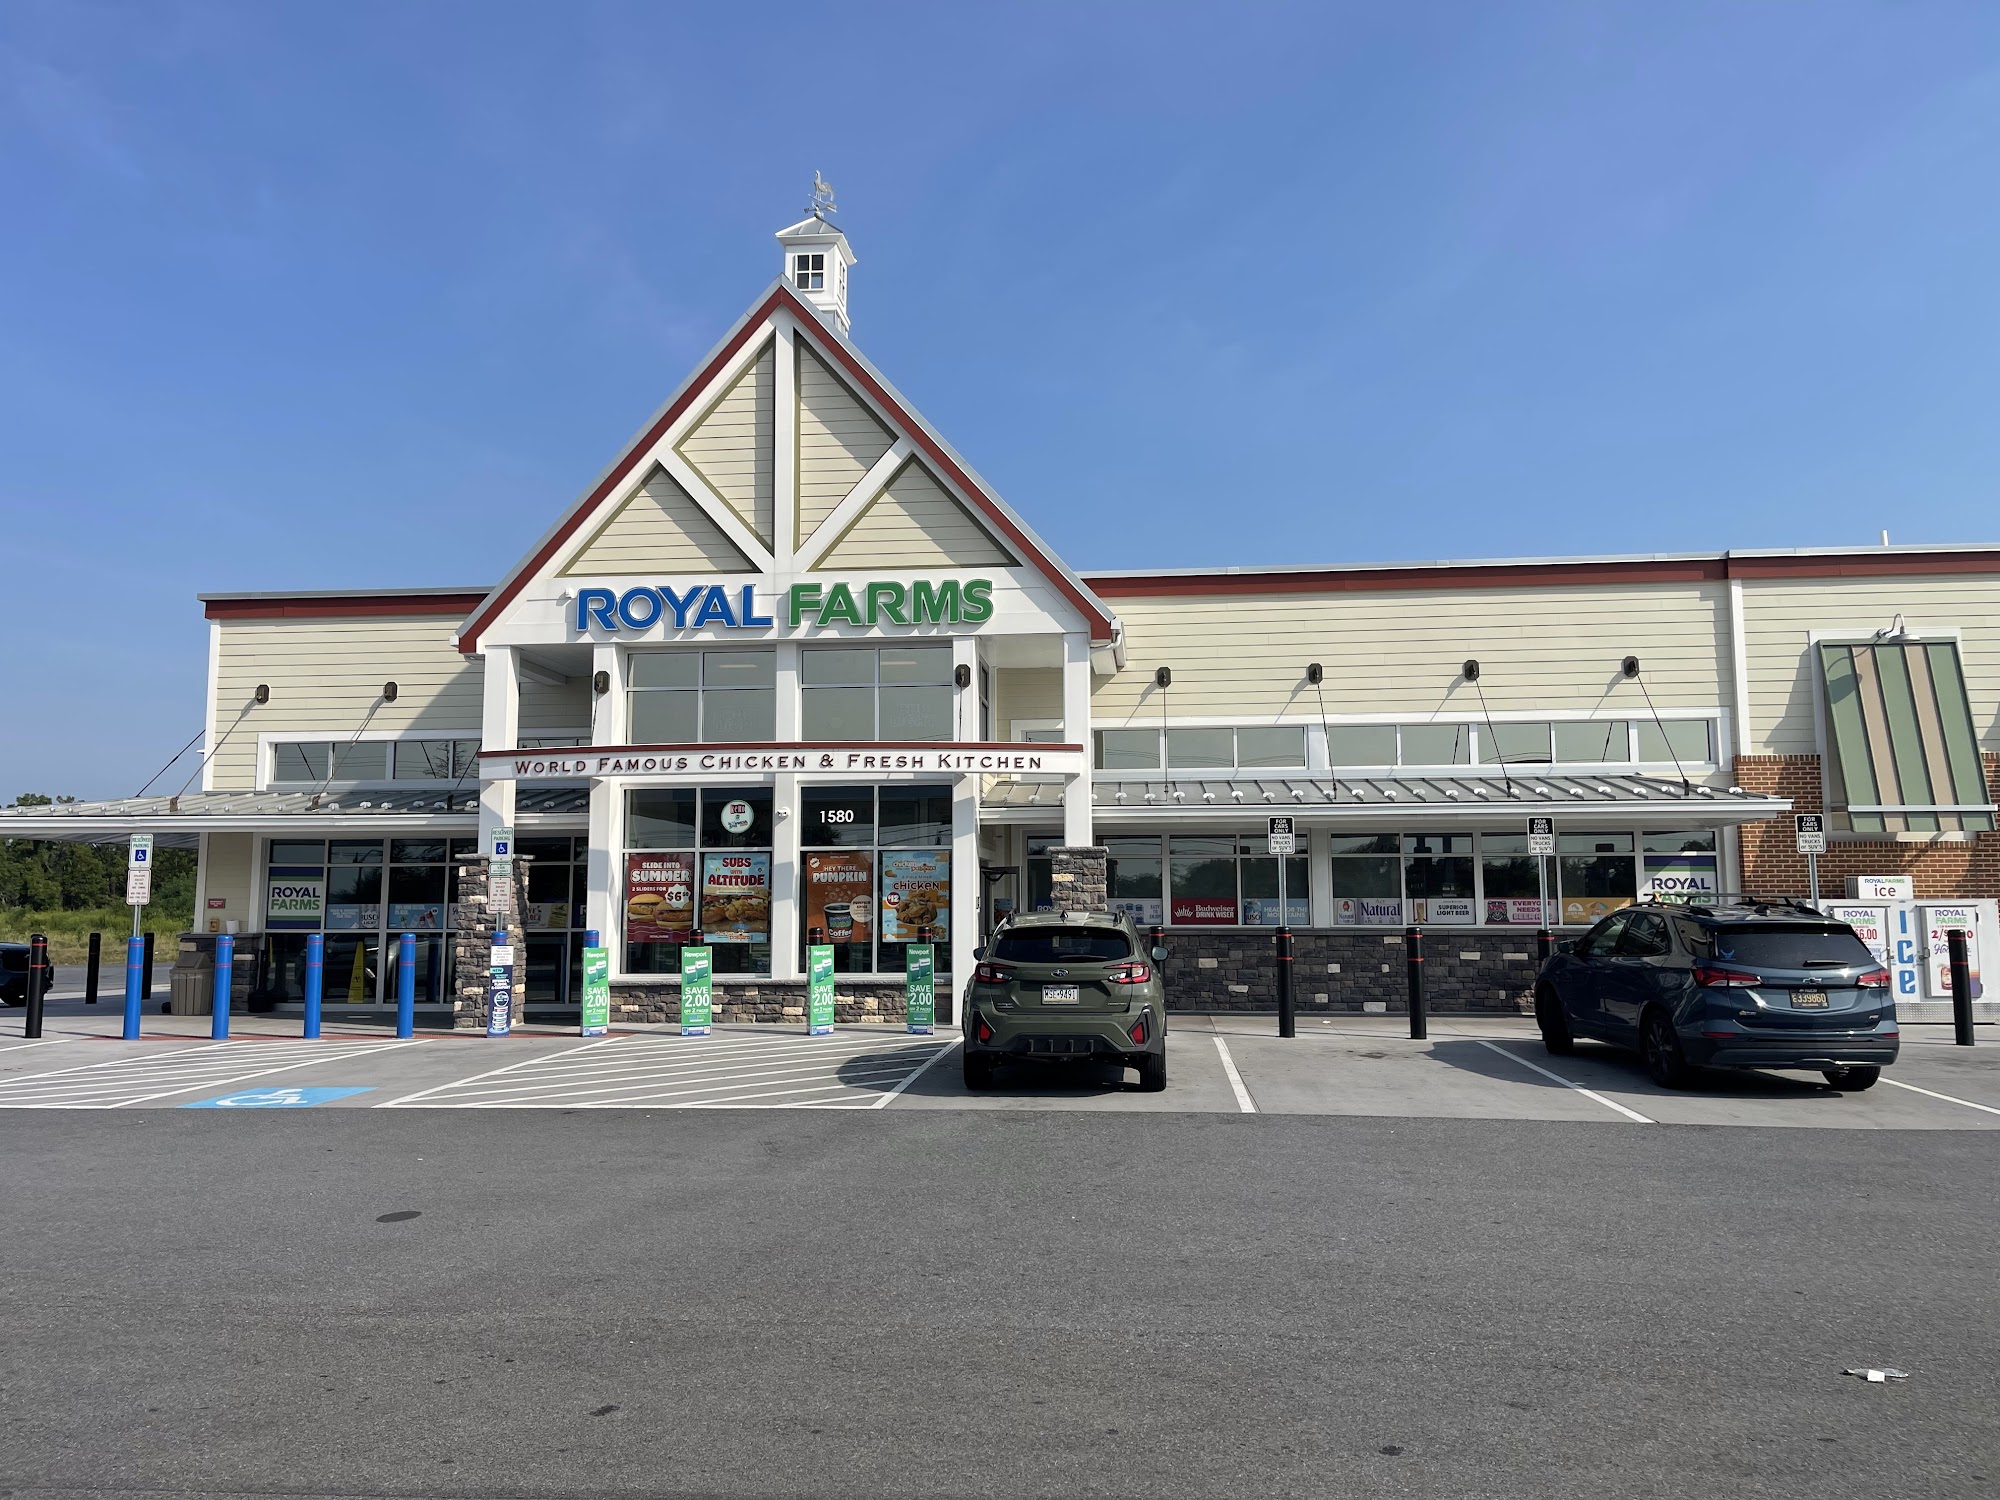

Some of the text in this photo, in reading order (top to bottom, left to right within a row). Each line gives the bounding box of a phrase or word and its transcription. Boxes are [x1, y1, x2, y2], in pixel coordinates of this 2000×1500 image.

[576, 579, 993, 632] ROYAL FARMS
[515, 754, 1042, 774] WORLD FAMOUS CHICKEN & FRESH KITCHEN
[819, 810, 854, 824] 1580
[722, 858, 751, 867] SUBS
[631, 870, 691, 882] SUMMER
[708, 874, 765, 886] ALTITUDE
[812, 872, 867, 882] PUMPKIN
[1652, 878, 1710, 889] ROYAL
[272, 887, 320, 898] ROYAL
[1874, 885, 1896, 896] ice
[271, 899, 320, 910] FARMS
[1361, 903, 1400, 916] Natural
[587, 987, 606, 995] SAVE
[1797, 993, 1826, 1002] 339860
